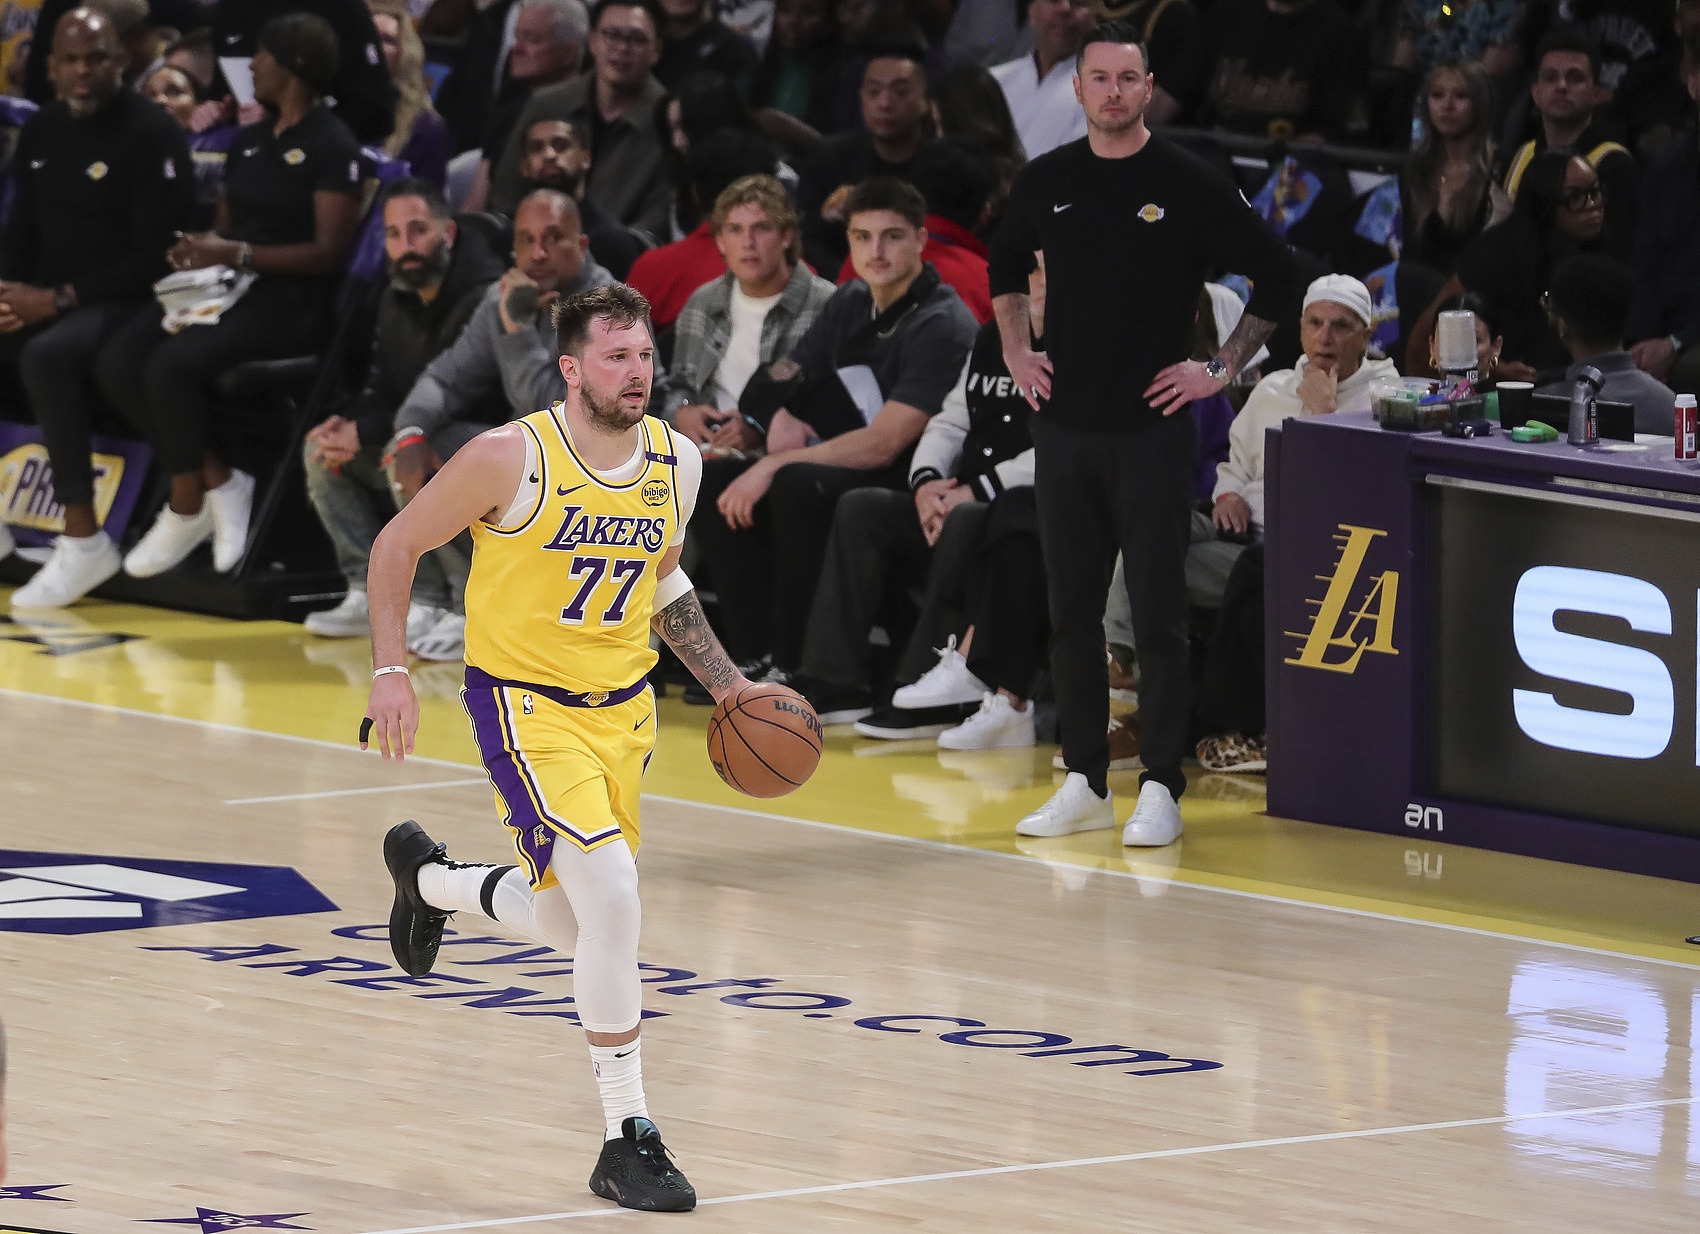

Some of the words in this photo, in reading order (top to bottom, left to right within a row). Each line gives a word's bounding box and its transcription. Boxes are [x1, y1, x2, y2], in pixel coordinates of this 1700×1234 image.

[644, 487, 668, 498] bibigo
[541, 505, 667, 554] LAKERS
[559, 556, 648, 625] 77
[1284, 523, 1400, 674] LA
[1513, 565, 1700, 767] S
